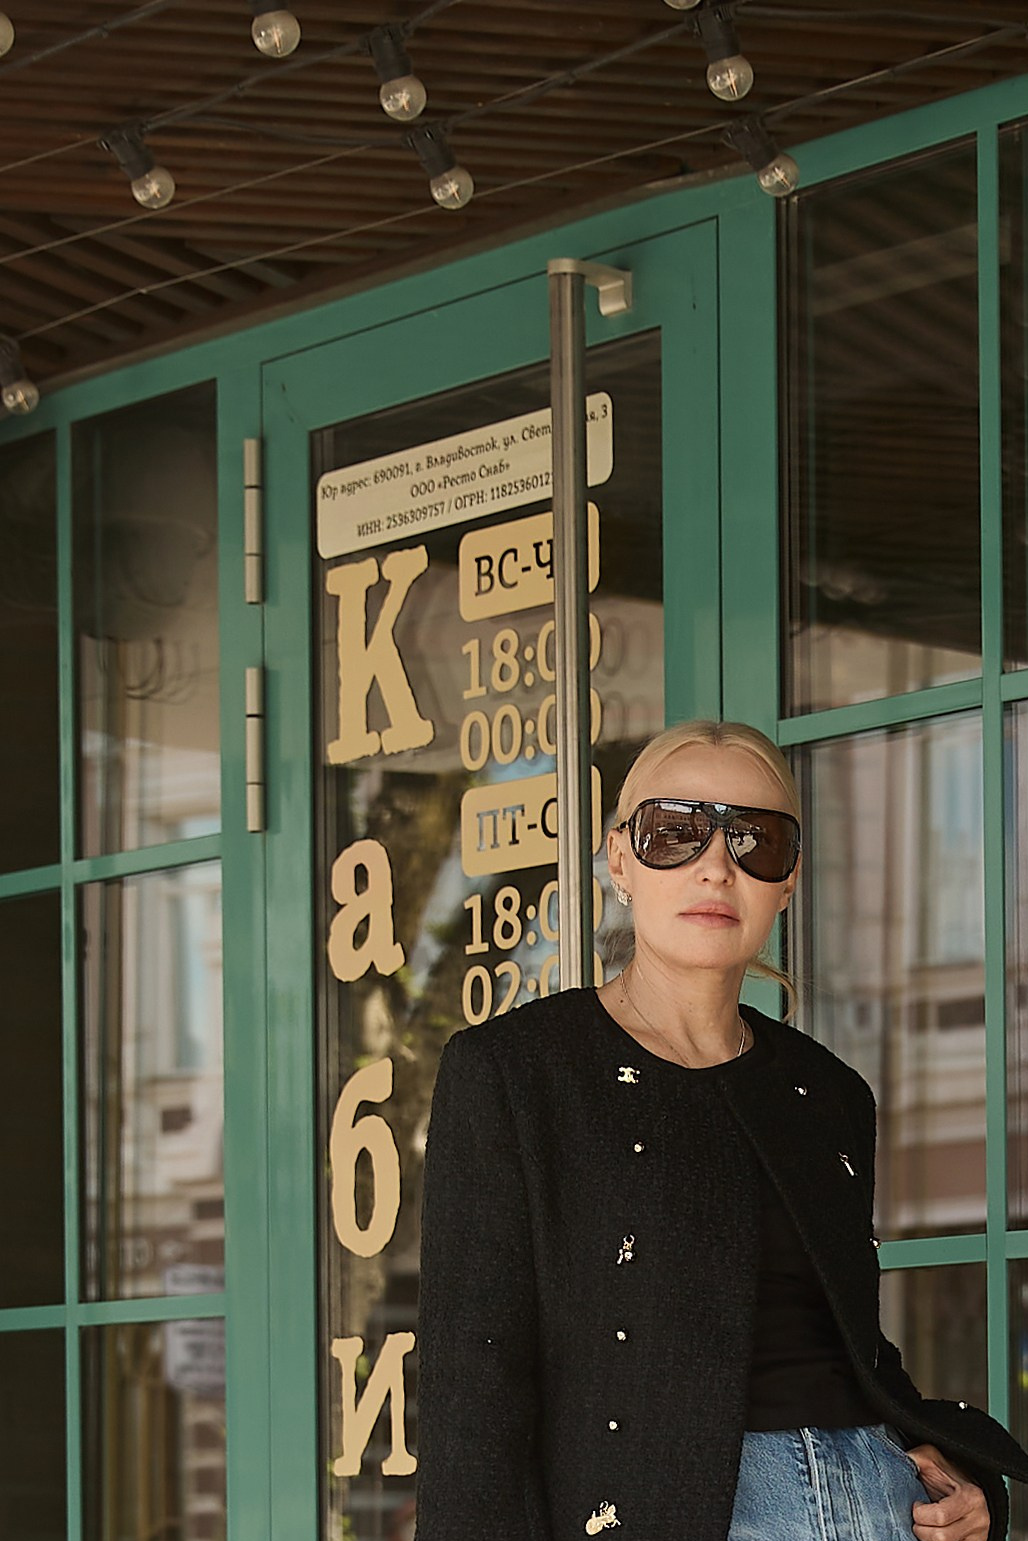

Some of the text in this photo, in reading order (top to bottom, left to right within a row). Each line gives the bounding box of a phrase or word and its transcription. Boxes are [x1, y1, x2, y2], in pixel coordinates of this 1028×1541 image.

[373, 462, 413, 485] 690091,
[426, 436, 500, 470] Владивосток,
[601, 403, 608, 419] 3
[357, 519, 384, 537] ИНН:
[386, 501, 445, 530] 2536309757
[454, 489, 488, 510] ОГРН:
[490, 471, 553, 501] 1182536012
[410, 459, 511, 498] ООО «Ресто Снаб»
[474, 539, 553, 597] ВС-Ч
[476, 798, 557, 852] ПТ-С
